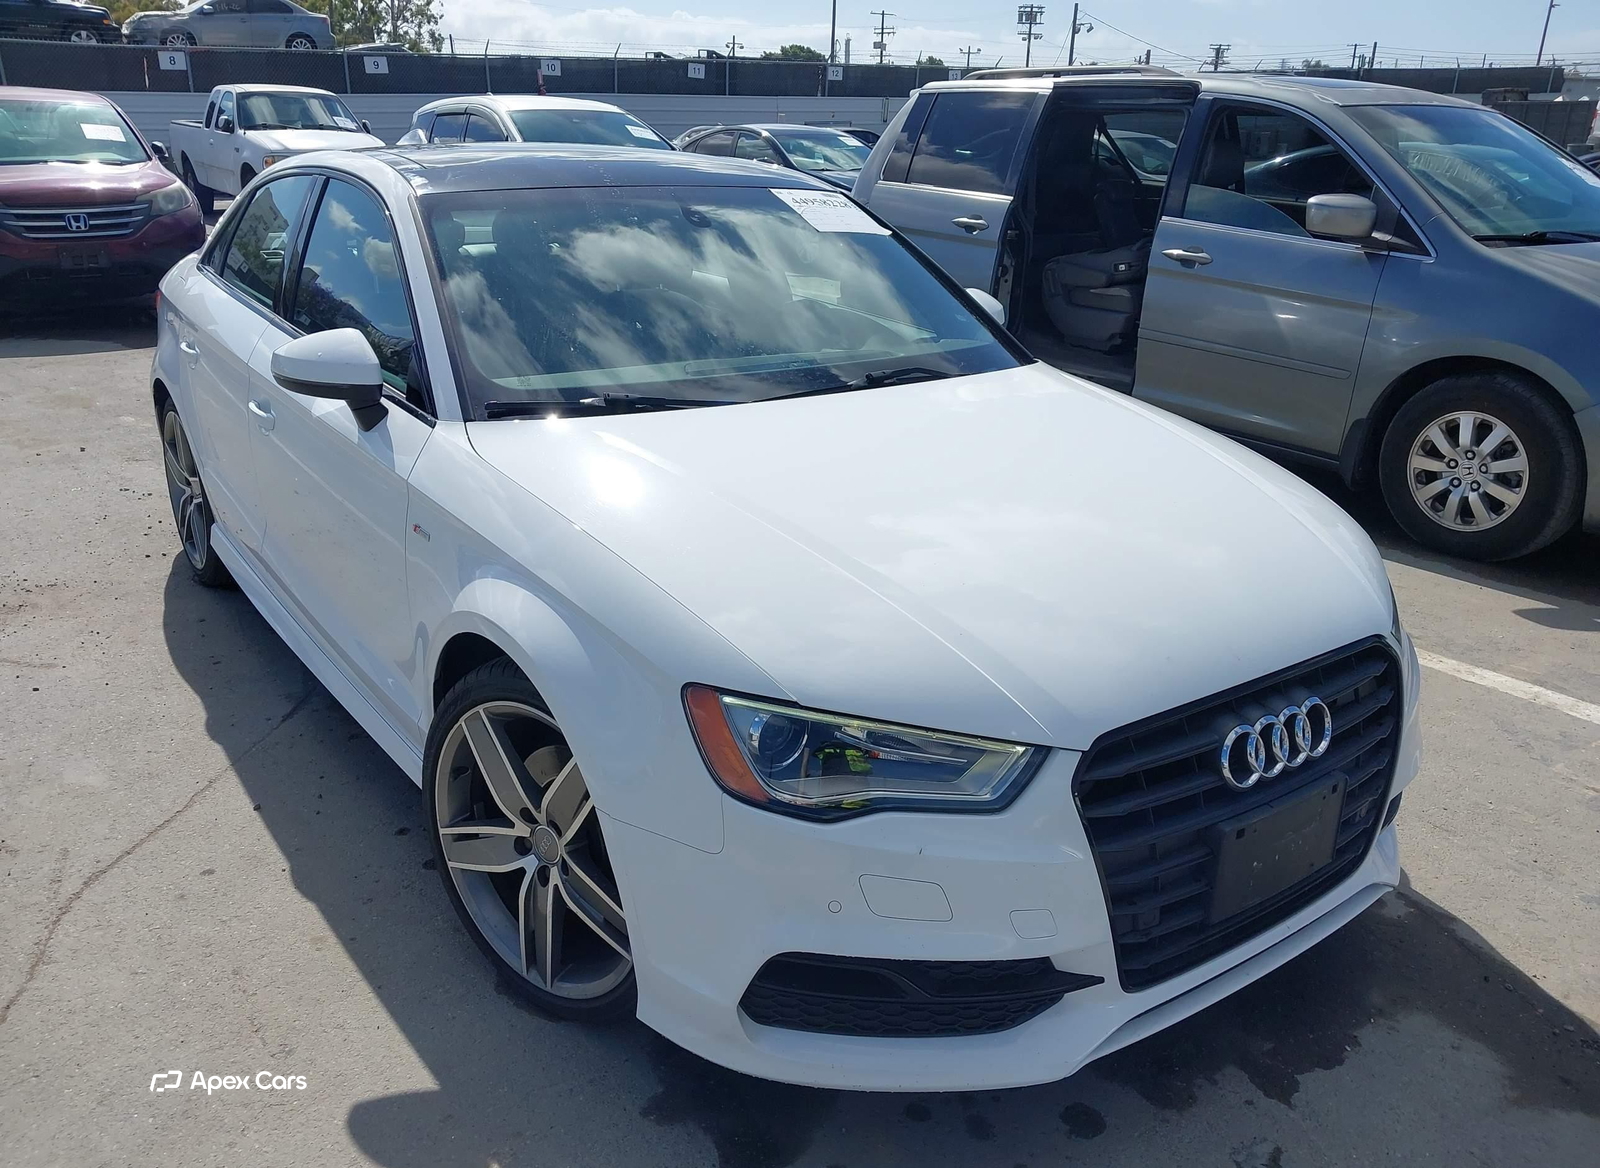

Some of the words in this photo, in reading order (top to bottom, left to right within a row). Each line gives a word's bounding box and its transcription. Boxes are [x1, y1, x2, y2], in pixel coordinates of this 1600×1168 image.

[169, 56, 176, 66] 8
[373, 60, 380, 70] 9
[546, 63, 556, 72] 10
[692, 67, 701, 76] 11
[831, 70, 840, 78] 12
